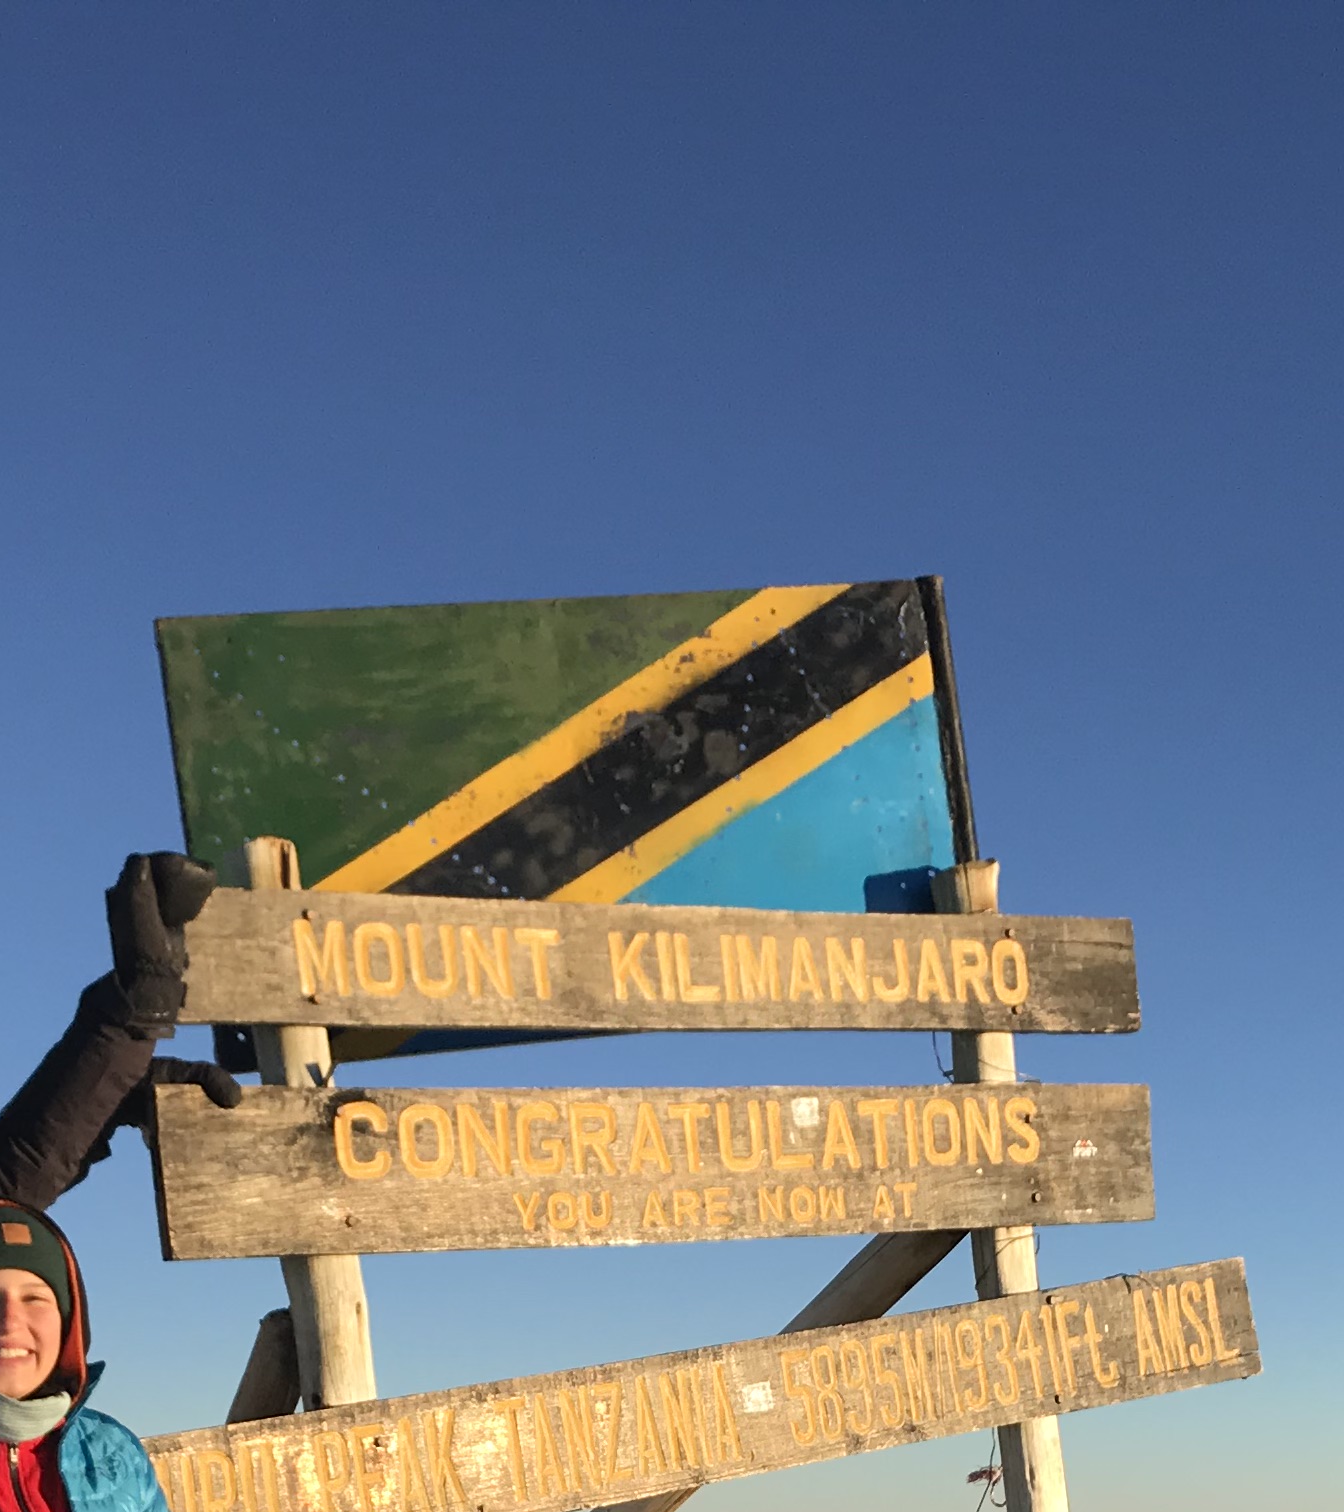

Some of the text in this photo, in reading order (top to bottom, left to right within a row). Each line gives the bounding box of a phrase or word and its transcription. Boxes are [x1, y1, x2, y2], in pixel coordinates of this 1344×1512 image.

[294, 918, 1029, 1005] MOUNT KILIMANJARO
[333, 1097, 1041, 1181] CONGRATULATIONS
[512, 1182, 918, 1231] YOU ARE NOW AT
[494, 1358, 744, 1503] TANZANIA
[1132, 1277, 1241, 1377] AMSL
